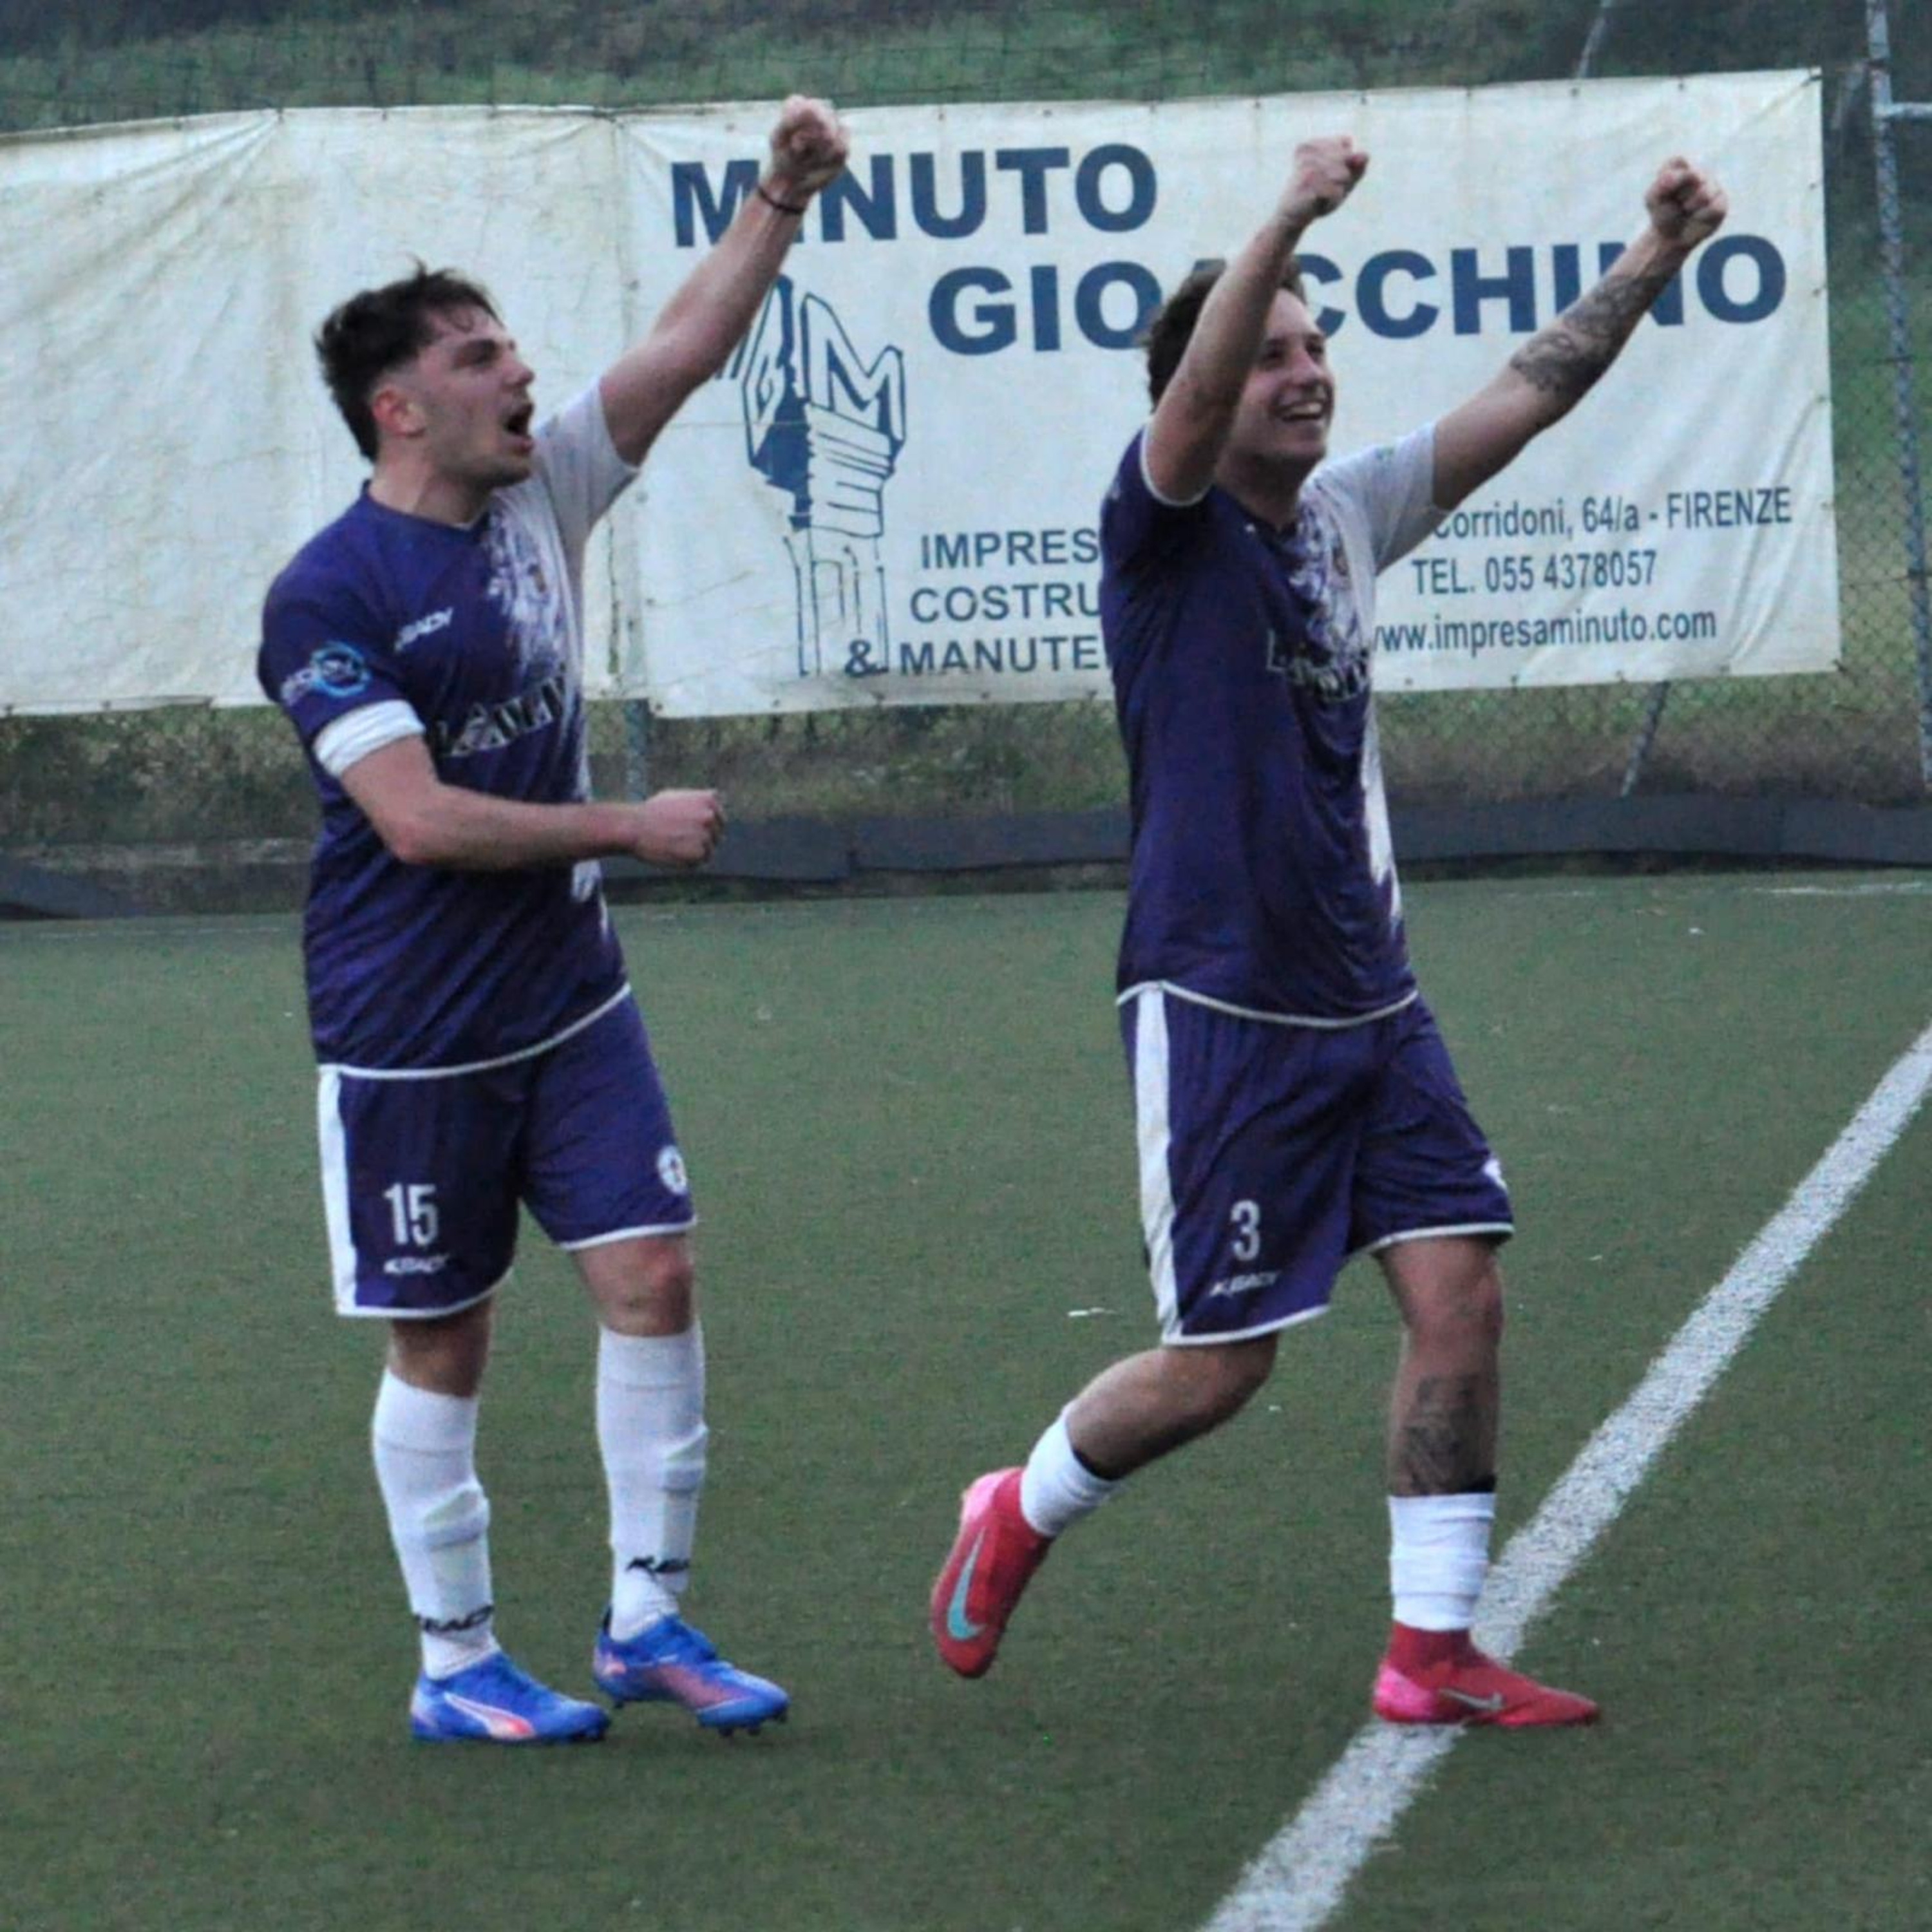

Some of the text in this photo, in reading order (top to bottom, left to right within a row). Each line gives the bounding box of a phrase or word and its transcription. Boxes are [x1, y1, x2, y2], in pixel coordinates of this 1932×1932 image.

[671, 144, 1157, 248] MNUTO
[929, 234, 1786, 355] GIOCHIO
[1582, 500, 1640, 533] 64/a
[1666, 488, 1792, 528] FIRENZE
[1412, 550, 1657, 594] TEL. 055 4378057
[844, 639, 873, 677] &
[1376, 608, 1717, 657] ww.impresaminuto.com
[383, 1182, 439, 1247] 15
[1230, 1200, 1260, 1262] 3
